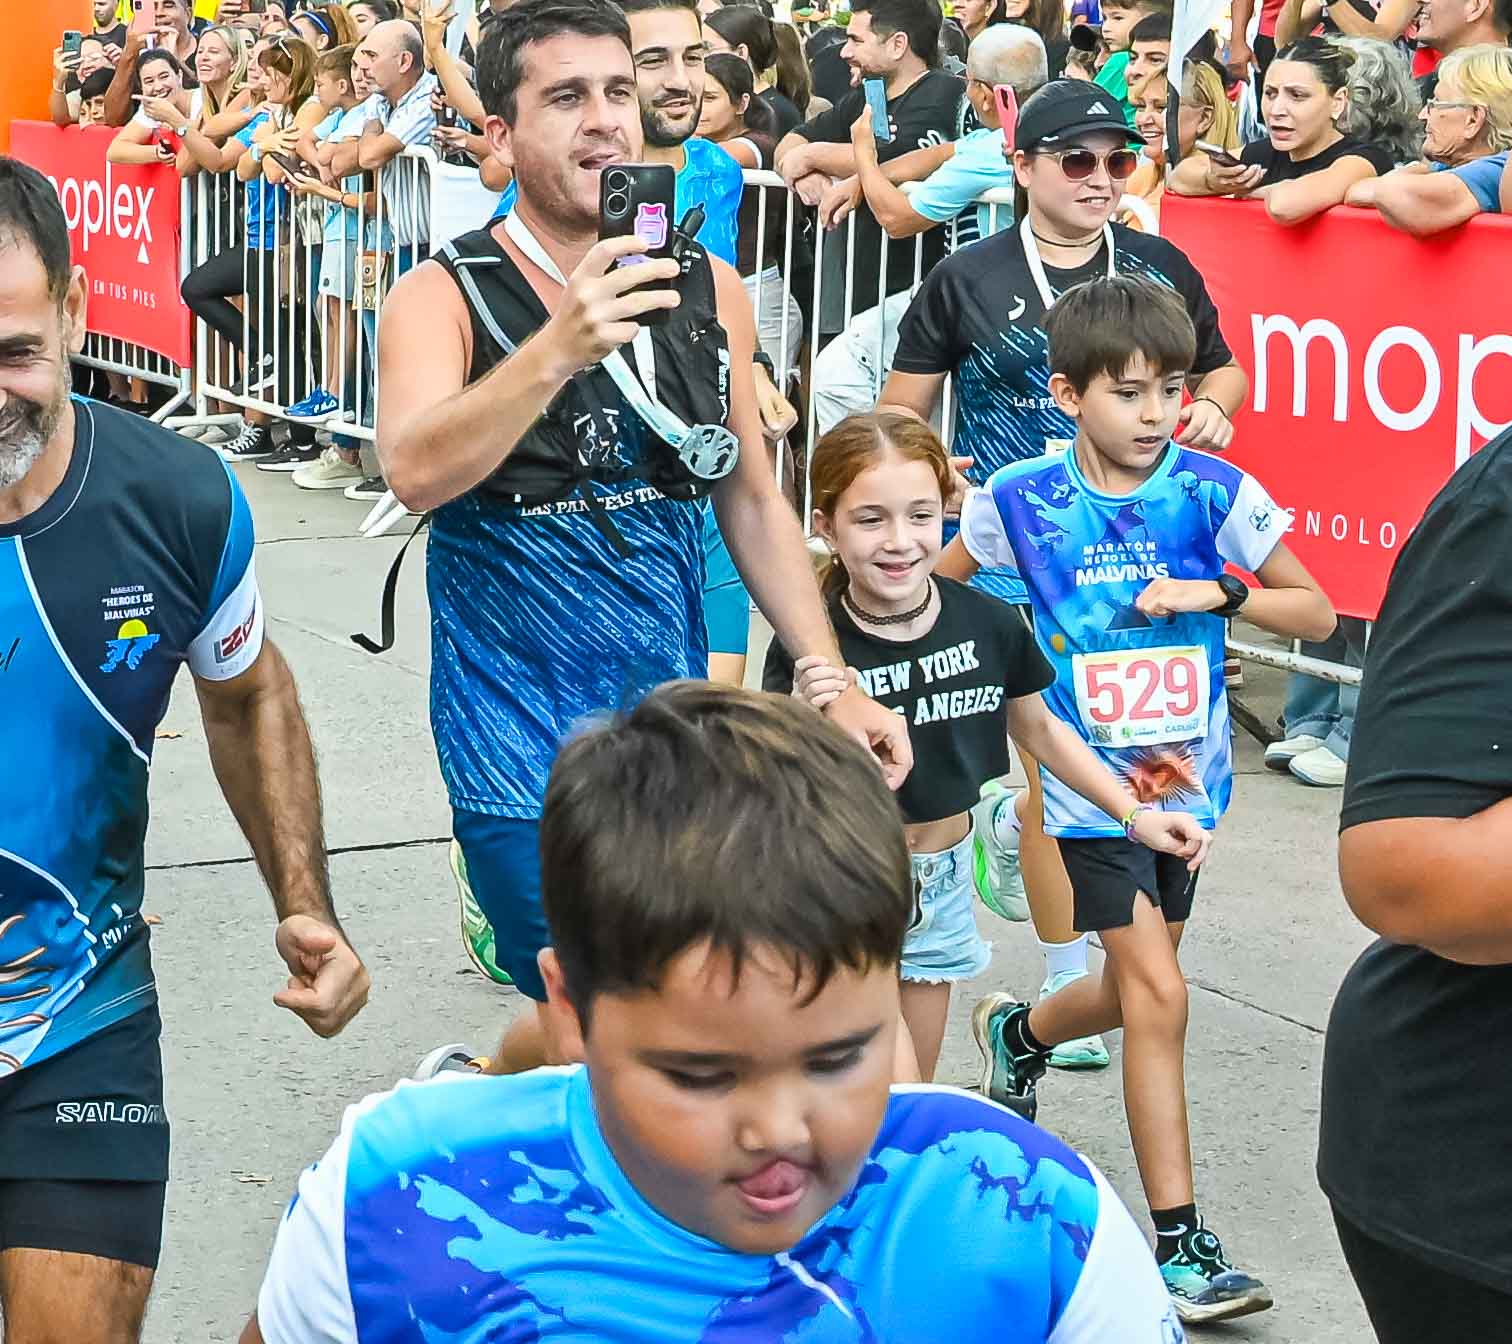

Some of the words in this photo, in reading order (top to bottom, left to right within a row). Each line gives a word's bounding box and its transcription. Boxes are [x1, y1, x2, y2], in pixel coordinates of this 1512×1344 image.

[1075, 562, 1169, 586] MALVINAS
[142, 592, 154, 603] DE
[857, 659, 912, 698] NEW
[918, 639, 980, 684] YORK
[913, 684, 1004, 726] ANGELES
[1085, 657, 1199, 723] 529
